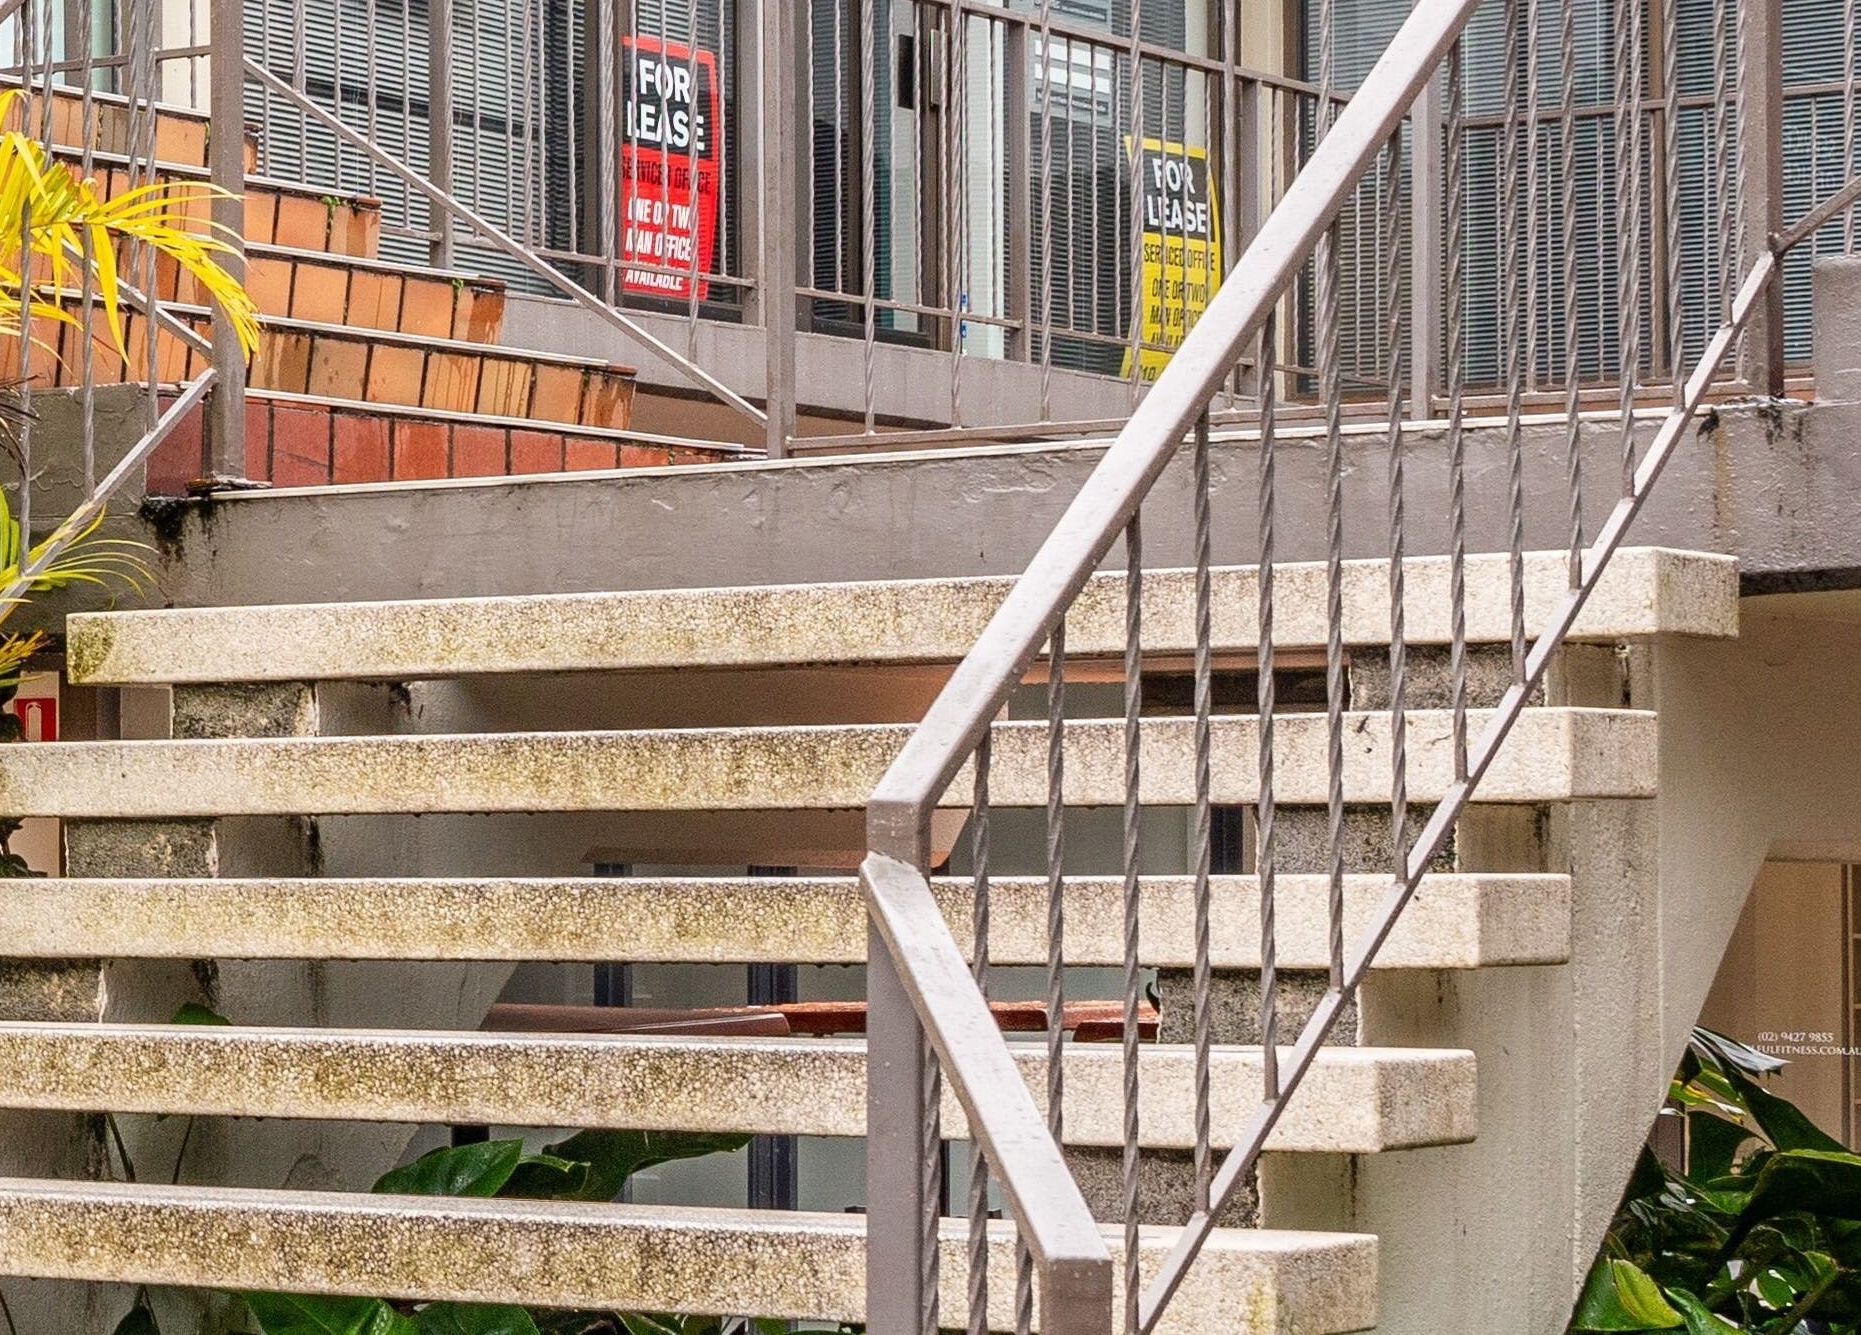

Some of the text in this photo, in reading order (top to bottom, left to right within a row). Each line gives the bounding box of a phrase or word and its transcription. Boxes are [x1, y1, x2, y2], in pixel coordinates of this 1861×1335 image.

[639, 58, 691, 104] FOR
[626, 100, 706, 152] LEASE
[1152, 158, 1196, 195] FOR
[672, 204, 693, 233] TW
[1146, 194, 1207, 234] LEASE
[1757, 1031, 1779, 1042] (02)
[1780, 1031, 1806, 1043] 9427
